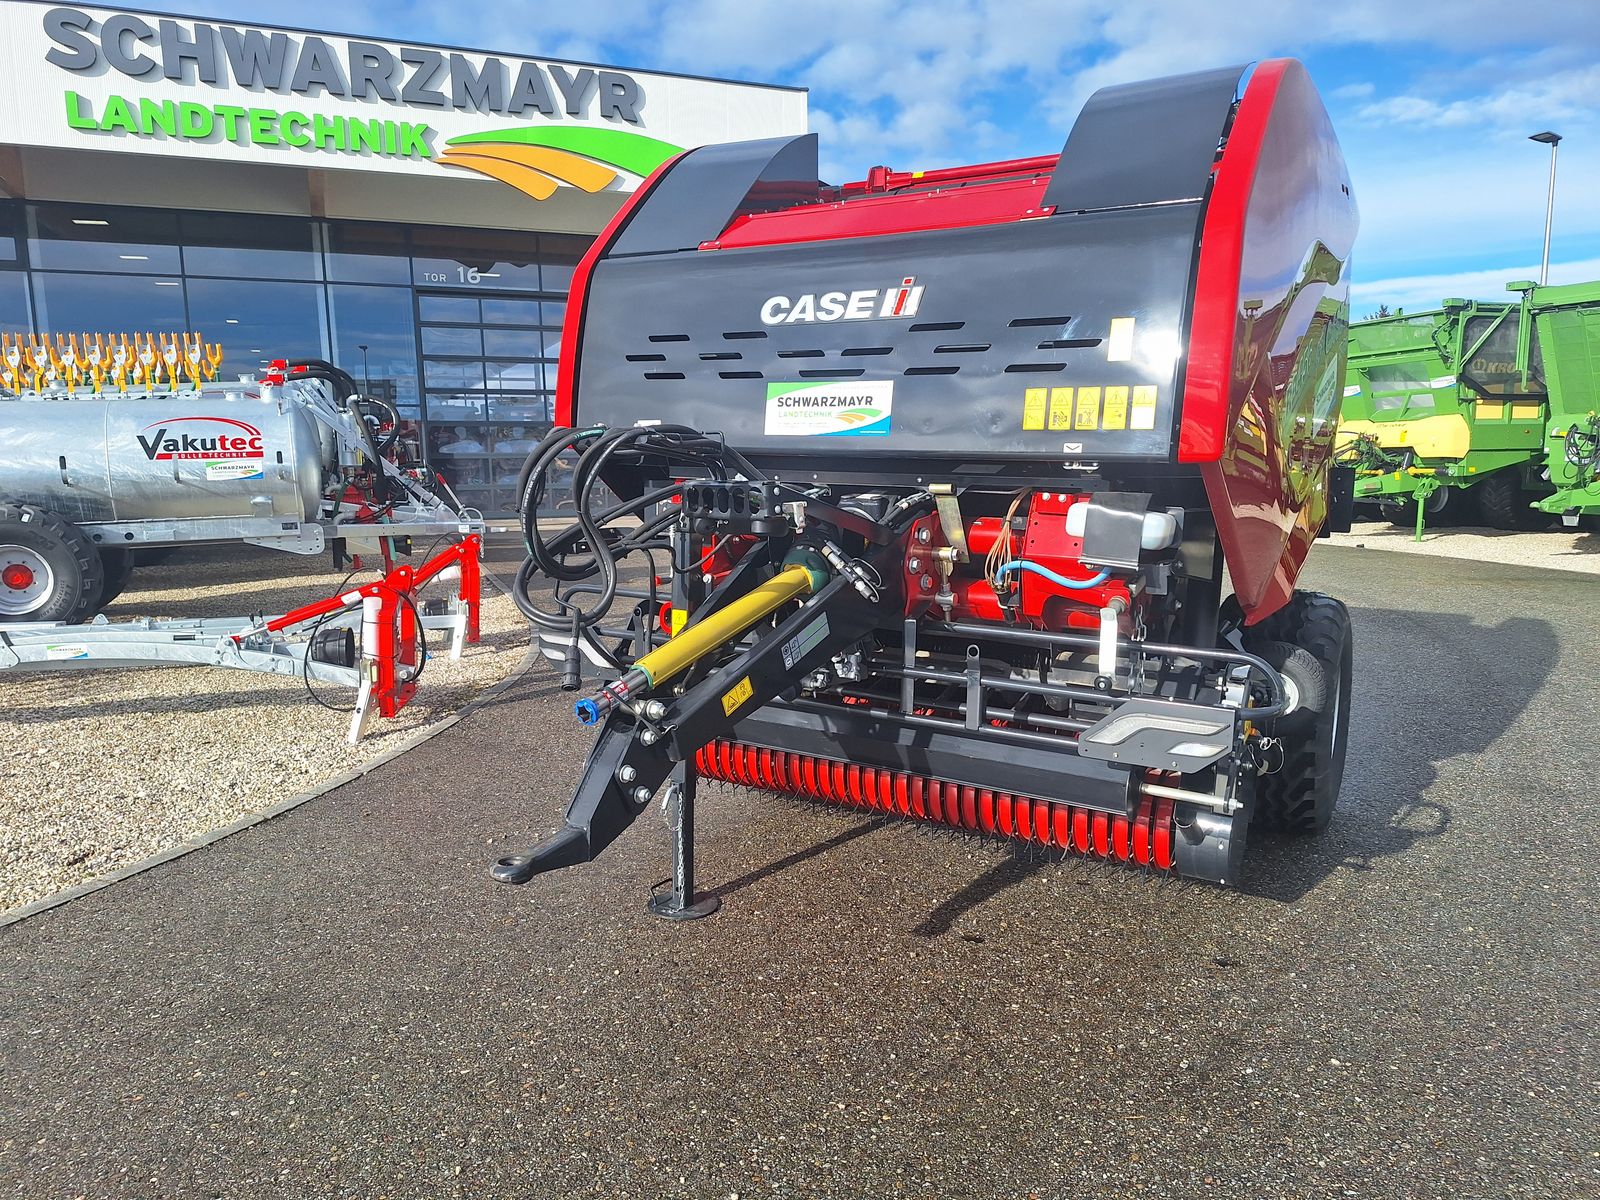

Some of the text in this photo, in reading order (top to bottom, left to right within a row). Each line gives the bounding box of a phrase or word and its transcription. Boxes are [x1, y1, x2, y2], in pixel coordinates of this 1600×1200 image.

[42, 7, 640, 123] SCHWARZMAYR
[64, 90, 431, 157] LANDTECHNIK
[424, 266, 481, 284] TOR 16
[760, 289, 878, 325] CASE
[777, 395, 874, 408] SCHWARZMAYR
[778, 410, 833, 419] LANDTECHNIK
[136, 428, 264, 460] Vakutec
